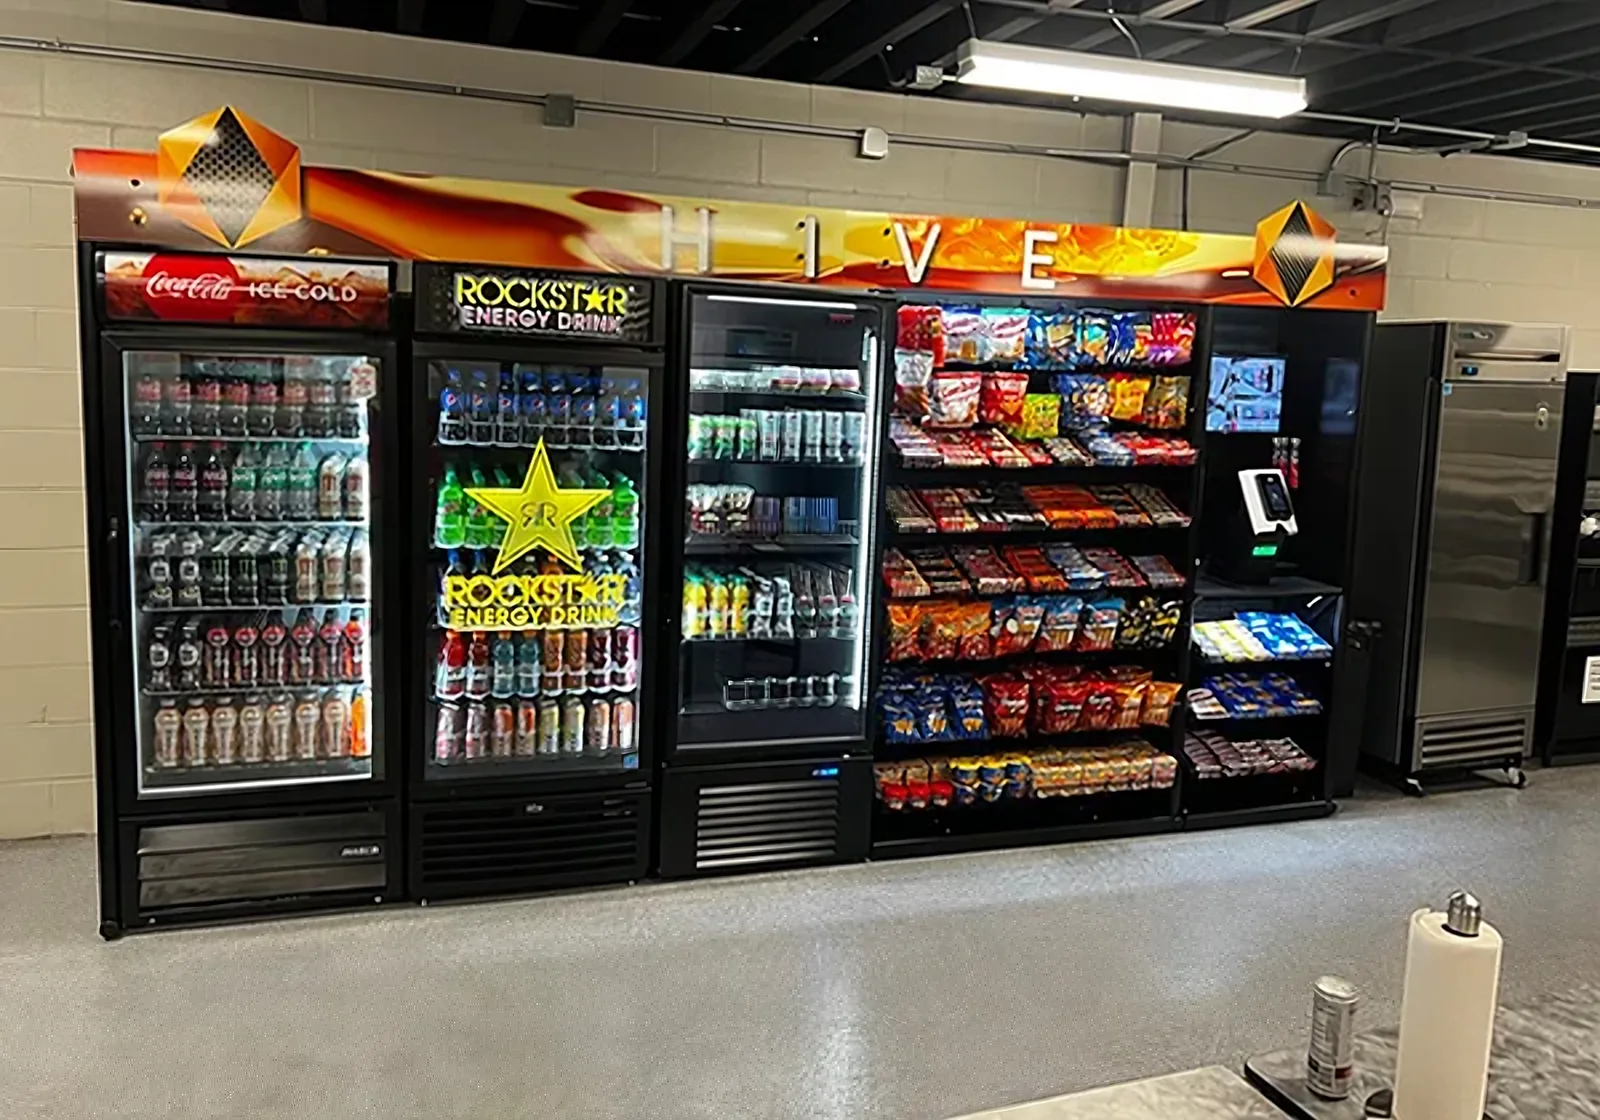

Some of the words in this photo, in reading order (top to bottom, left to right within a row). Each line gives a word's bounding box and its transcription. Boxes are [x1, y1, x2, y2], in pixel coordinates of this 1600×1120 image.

[660, 204, 1058, 289] HIVE
[146, 271, 238, 300] Coca-Cola
[250, 282, 288, 299] ICE
[295, 284, 357, 302] COLD
[461, 304, 552, 328] ENERGY
[453, 606, 544, 627] ENERGY
